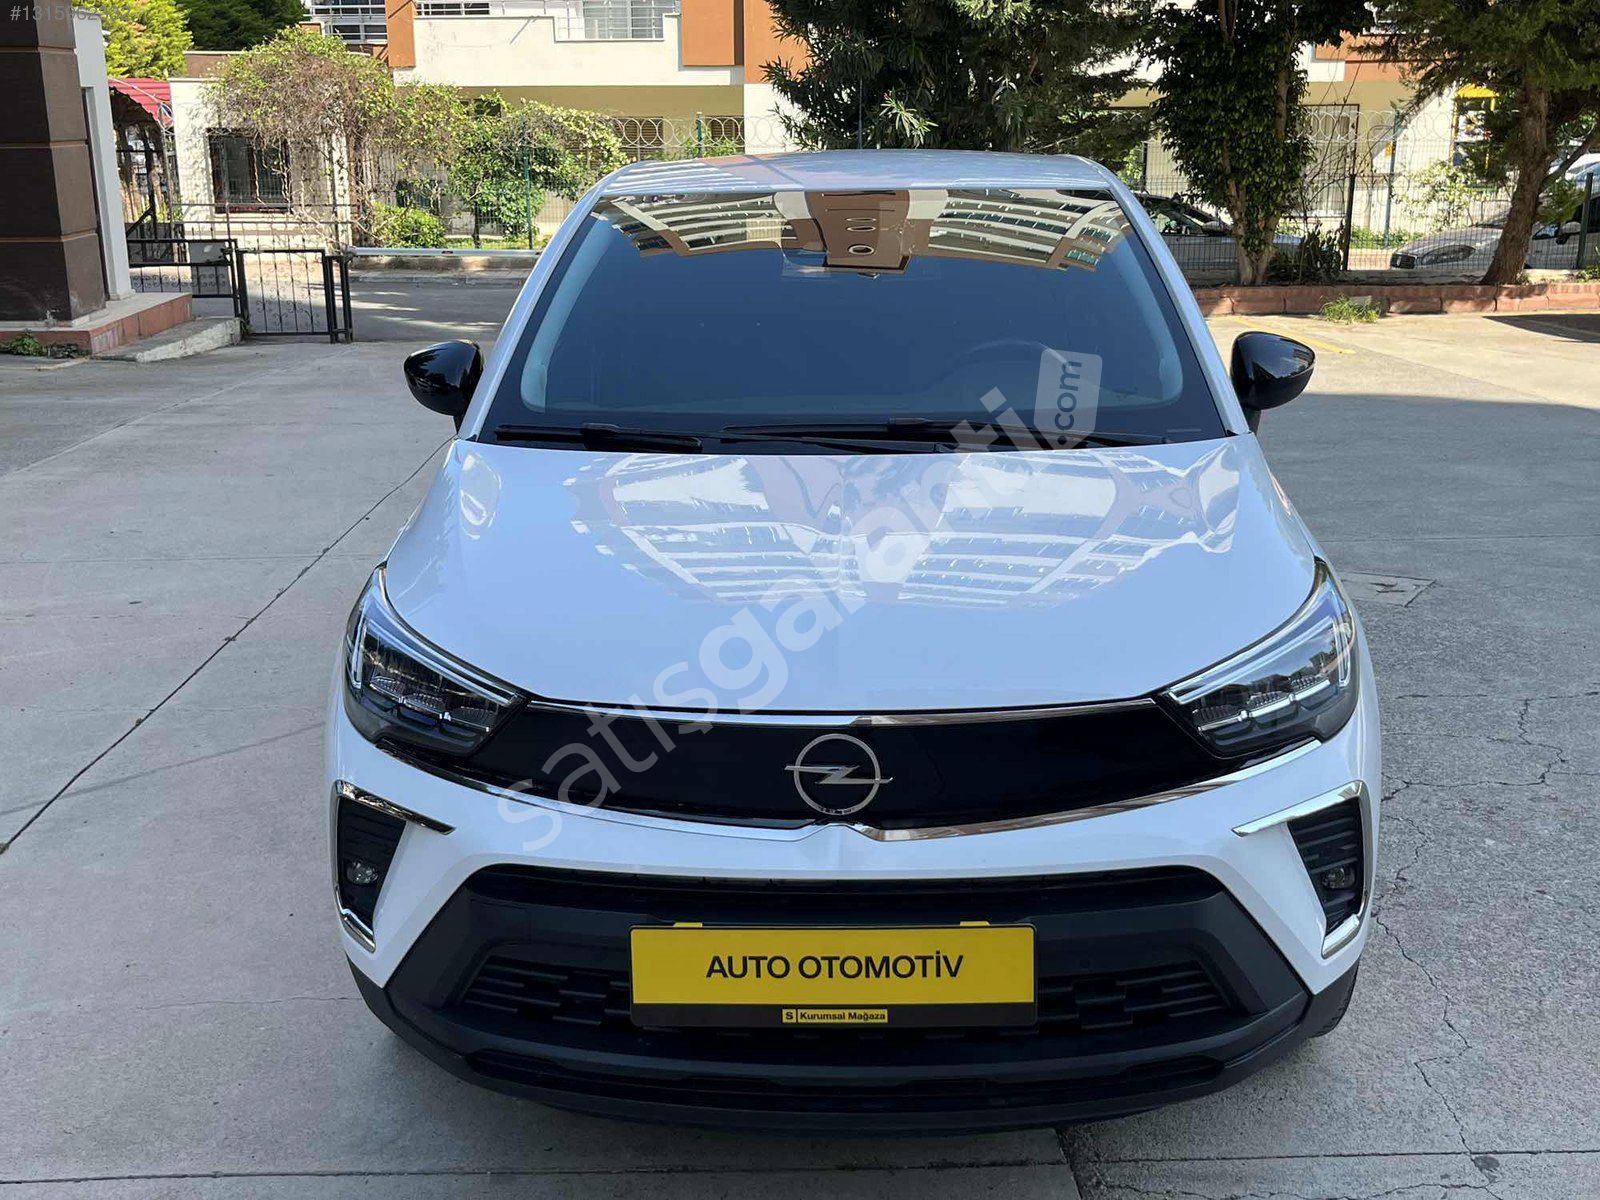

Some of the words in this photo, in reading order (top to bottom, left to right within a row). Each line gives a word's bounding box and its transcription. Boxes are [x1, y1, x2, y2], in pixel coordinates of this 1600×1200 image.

[706, 954, 791, 979] AUTO
[799, 949, 964, 979] OTOMOTİV
[800, 1010, 846, 1021] Kurumsal
[848, 1010, 886, 1022] Mağaza
